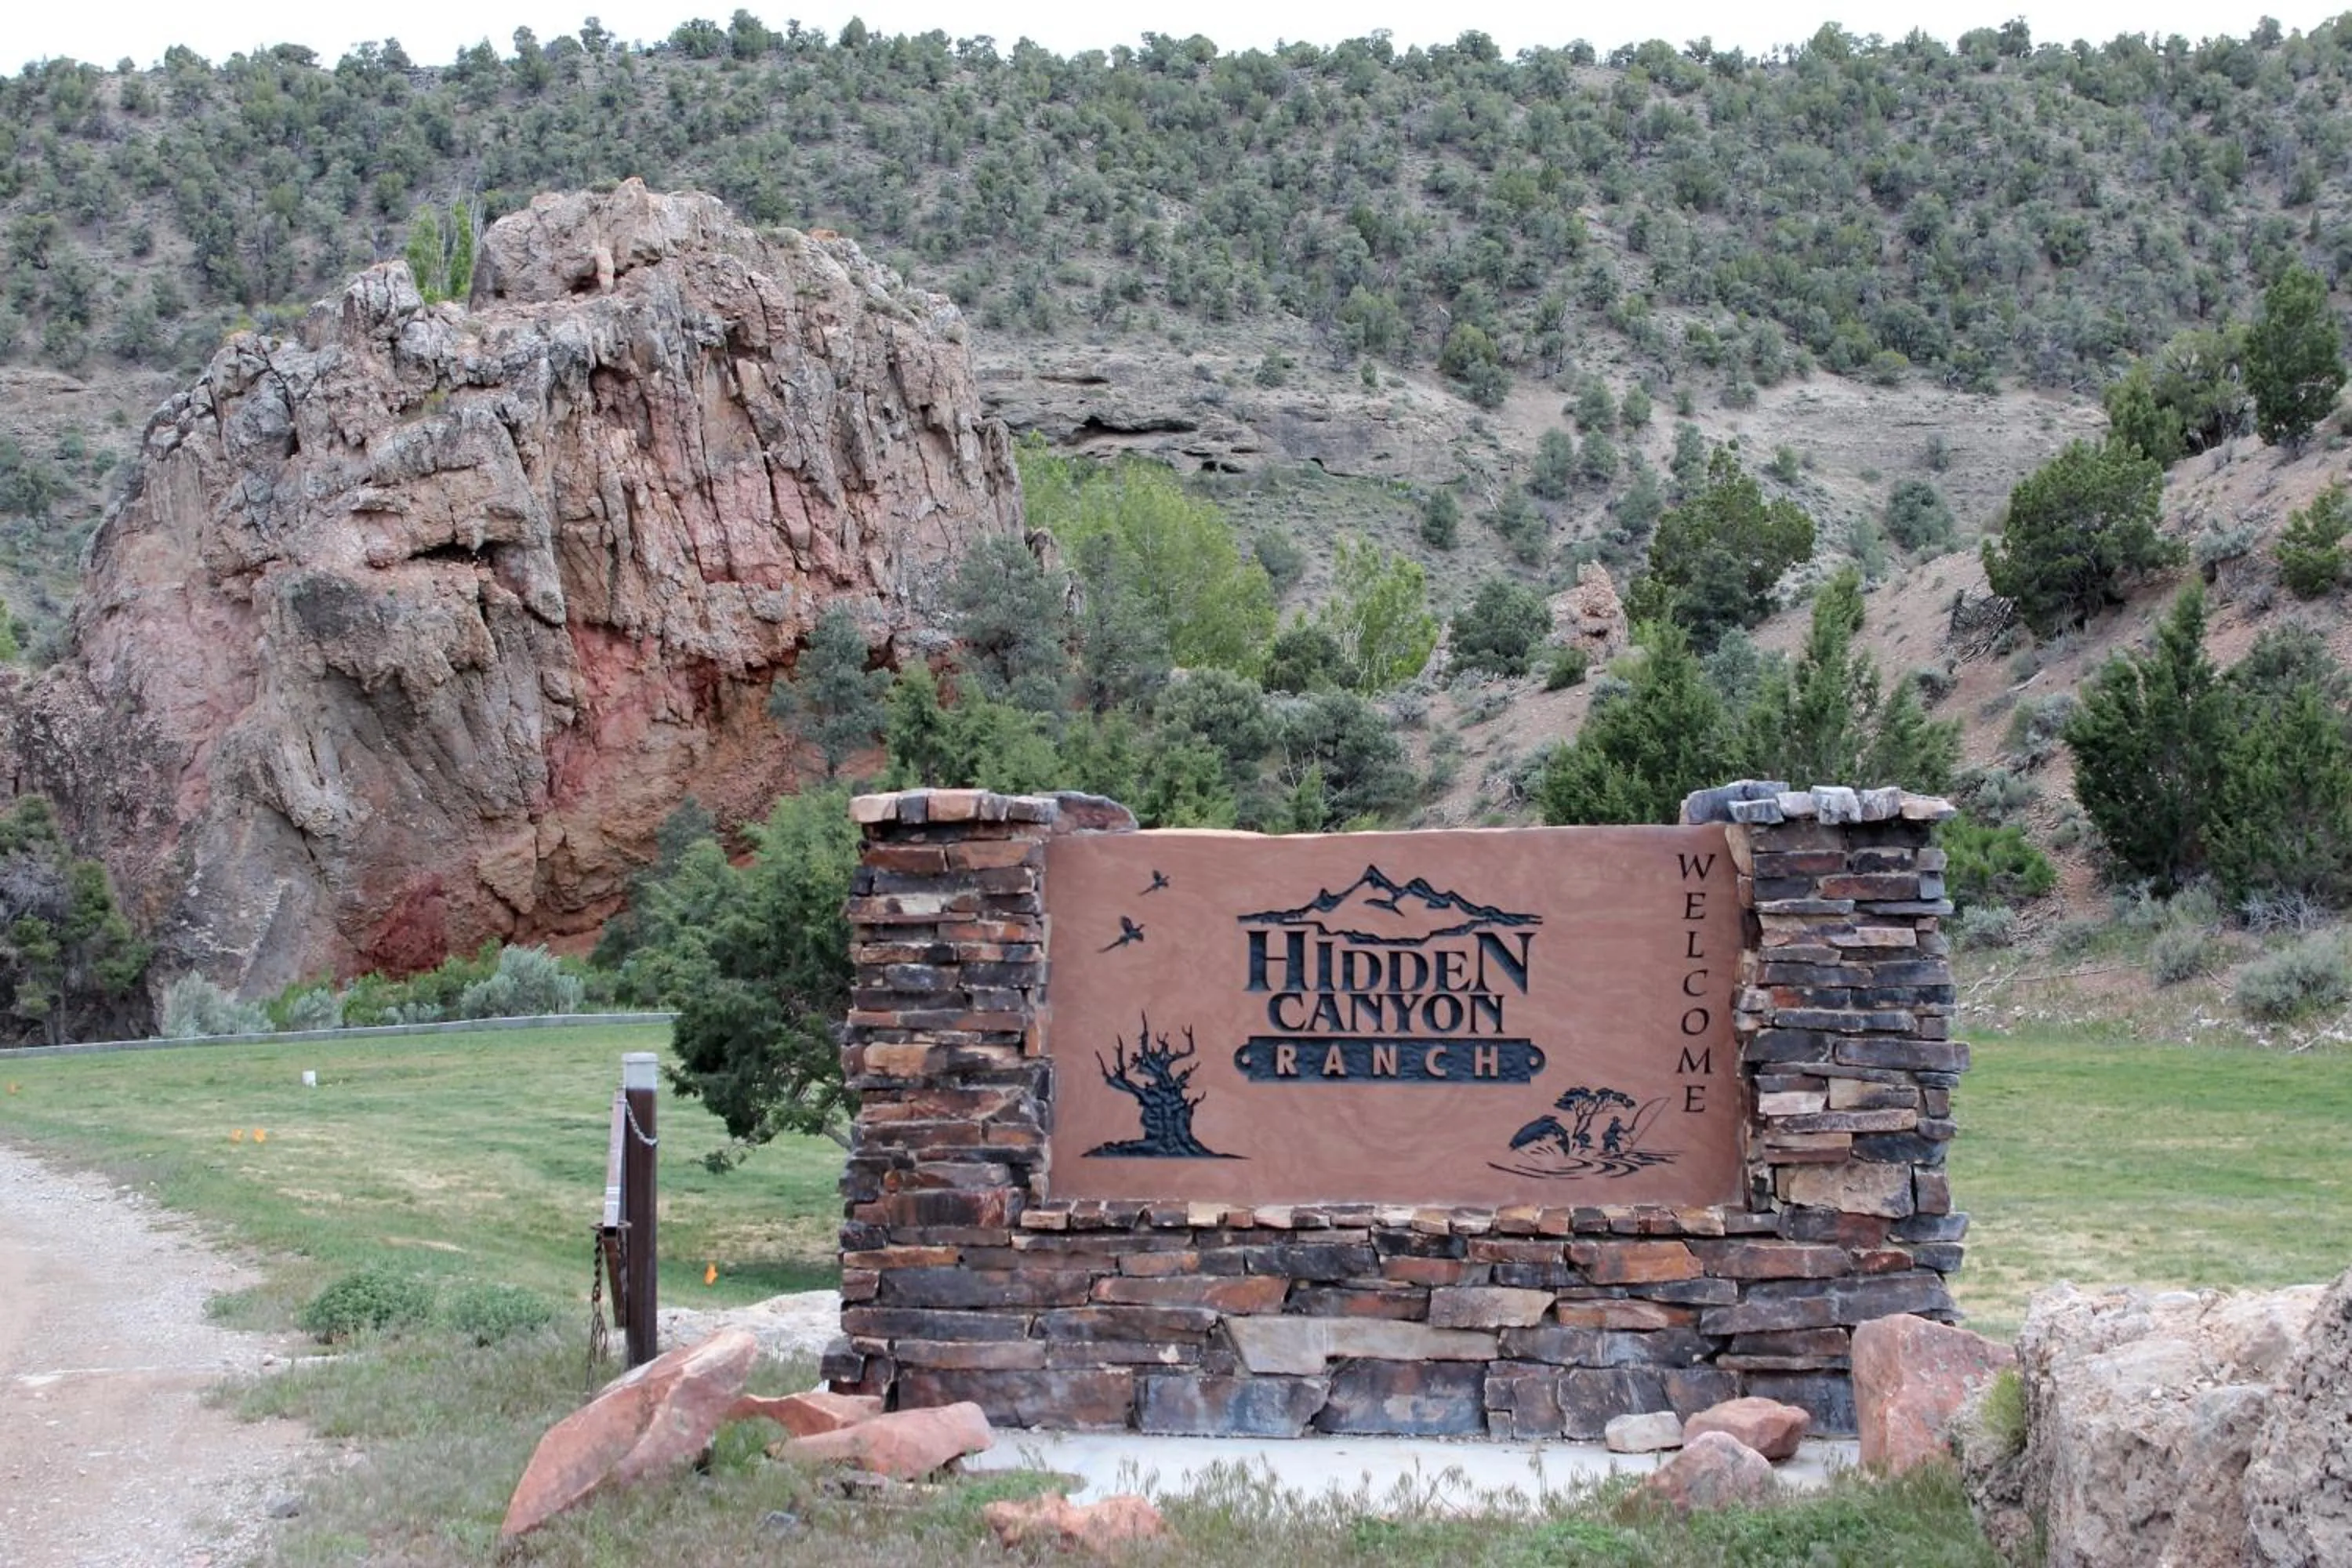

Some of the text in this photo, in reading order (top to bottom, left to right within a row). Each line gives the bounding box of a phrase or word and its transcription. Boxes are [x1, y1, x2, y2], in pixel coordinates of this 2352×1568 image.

[1244, 931, 1537, 994] HIDDEN
[1675, 853, 1716, 1112] WELCOME
[1267, 993, 1504, 1034] CANYON
[1275, 1044, 1499, 1077] RANCH
